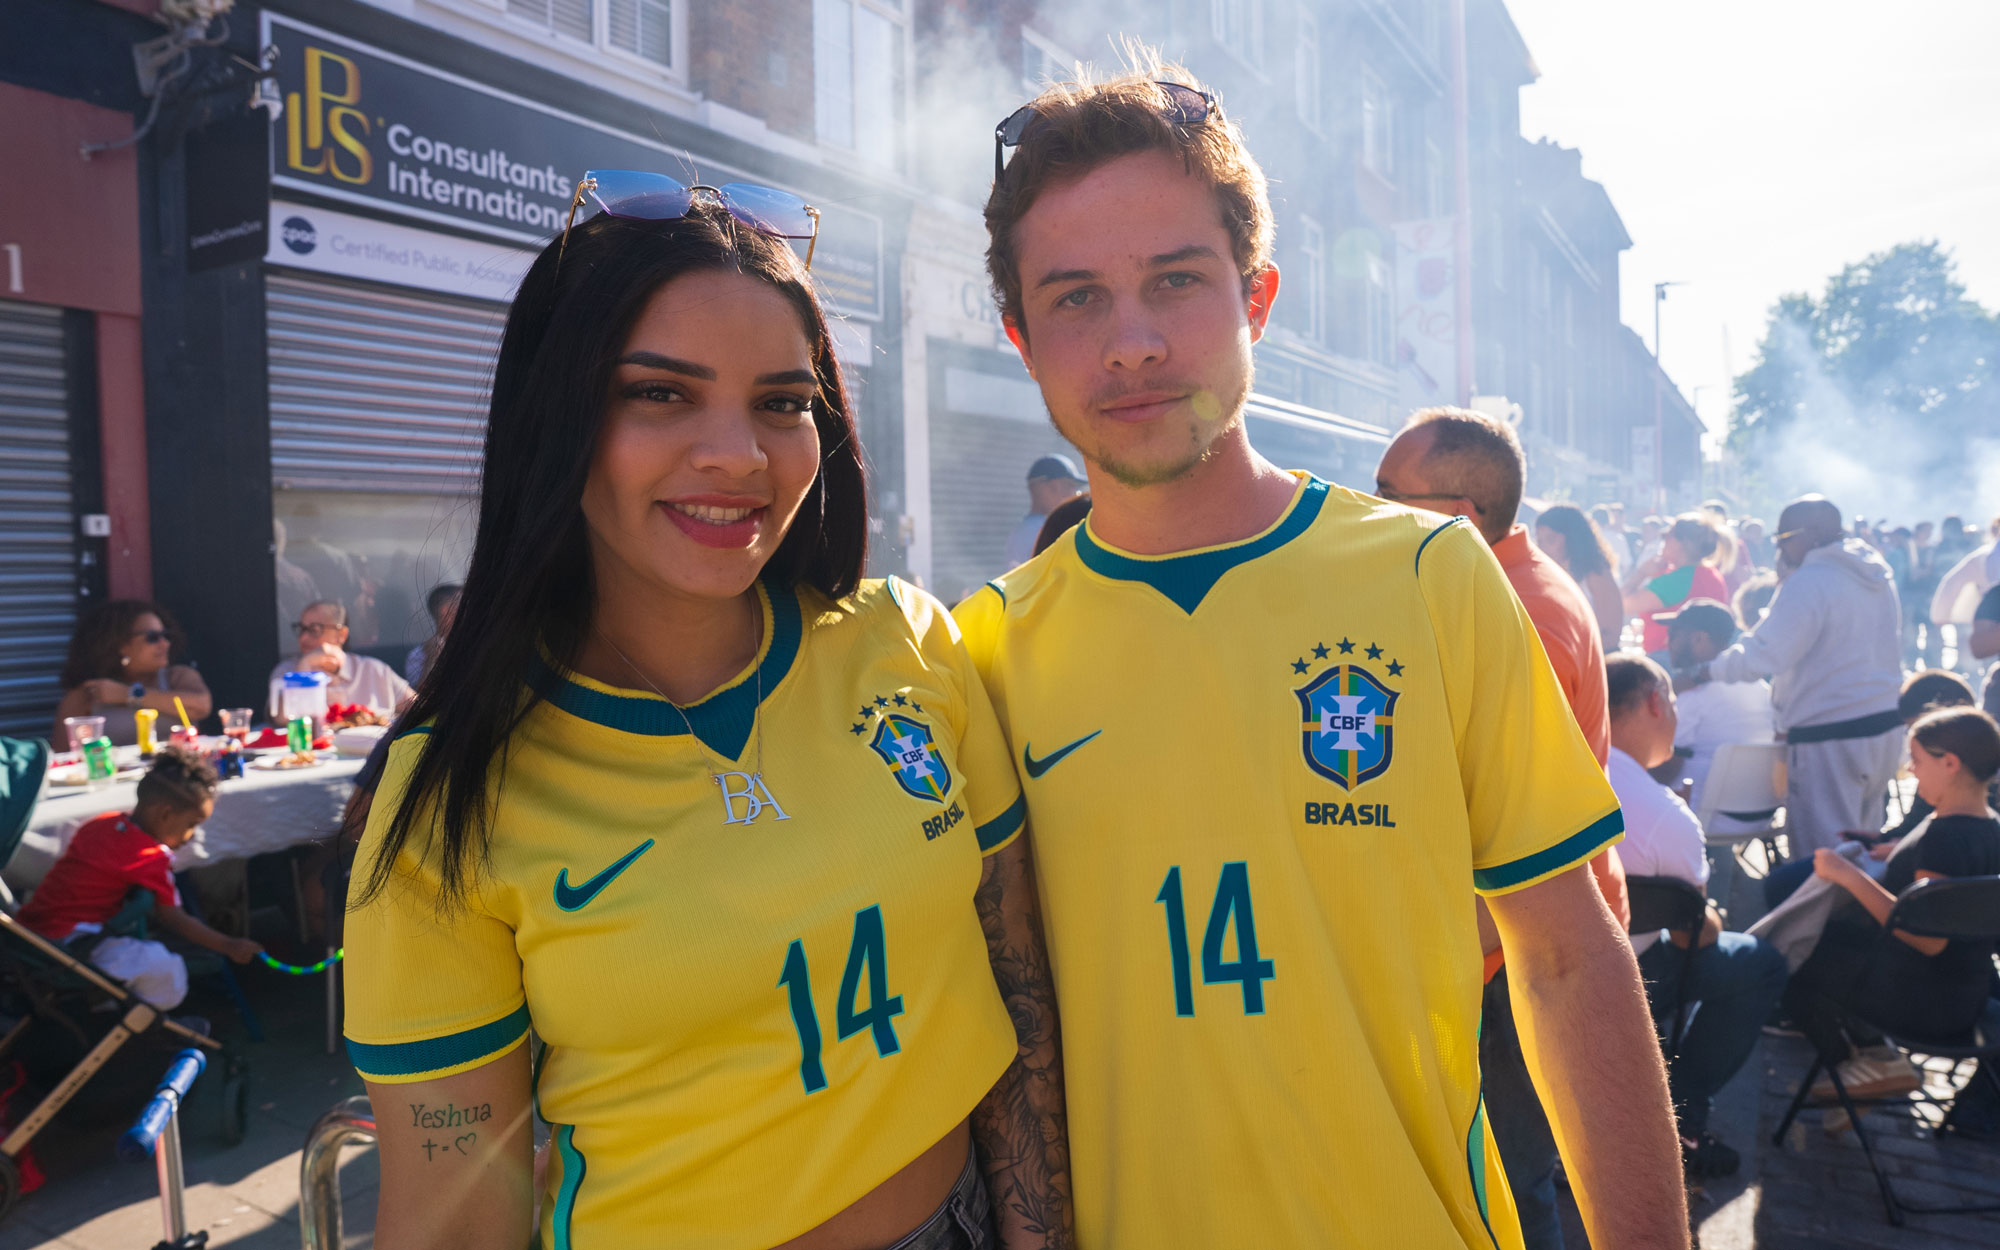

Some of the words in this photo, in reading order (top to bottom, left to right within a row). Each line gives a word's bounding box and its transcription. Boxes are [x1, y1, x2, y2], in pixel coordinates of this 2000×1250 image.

[387, 123, 571, 198] Consultants
[329, 234, 409, 266] Certified
[412, 248, 460, 276] Public
[1329, 715, 1367, 731] CBF
[901, 748, 925, 765] CBF
[921, 799, 965, 842] BRASIL
[1304, 801, 1397, 829] BRASIL
[1154, 860, 1276, 1018] 14
[776, 902, 905, 1096] 14
[409, 1102, 492, 1129] Yeshua
